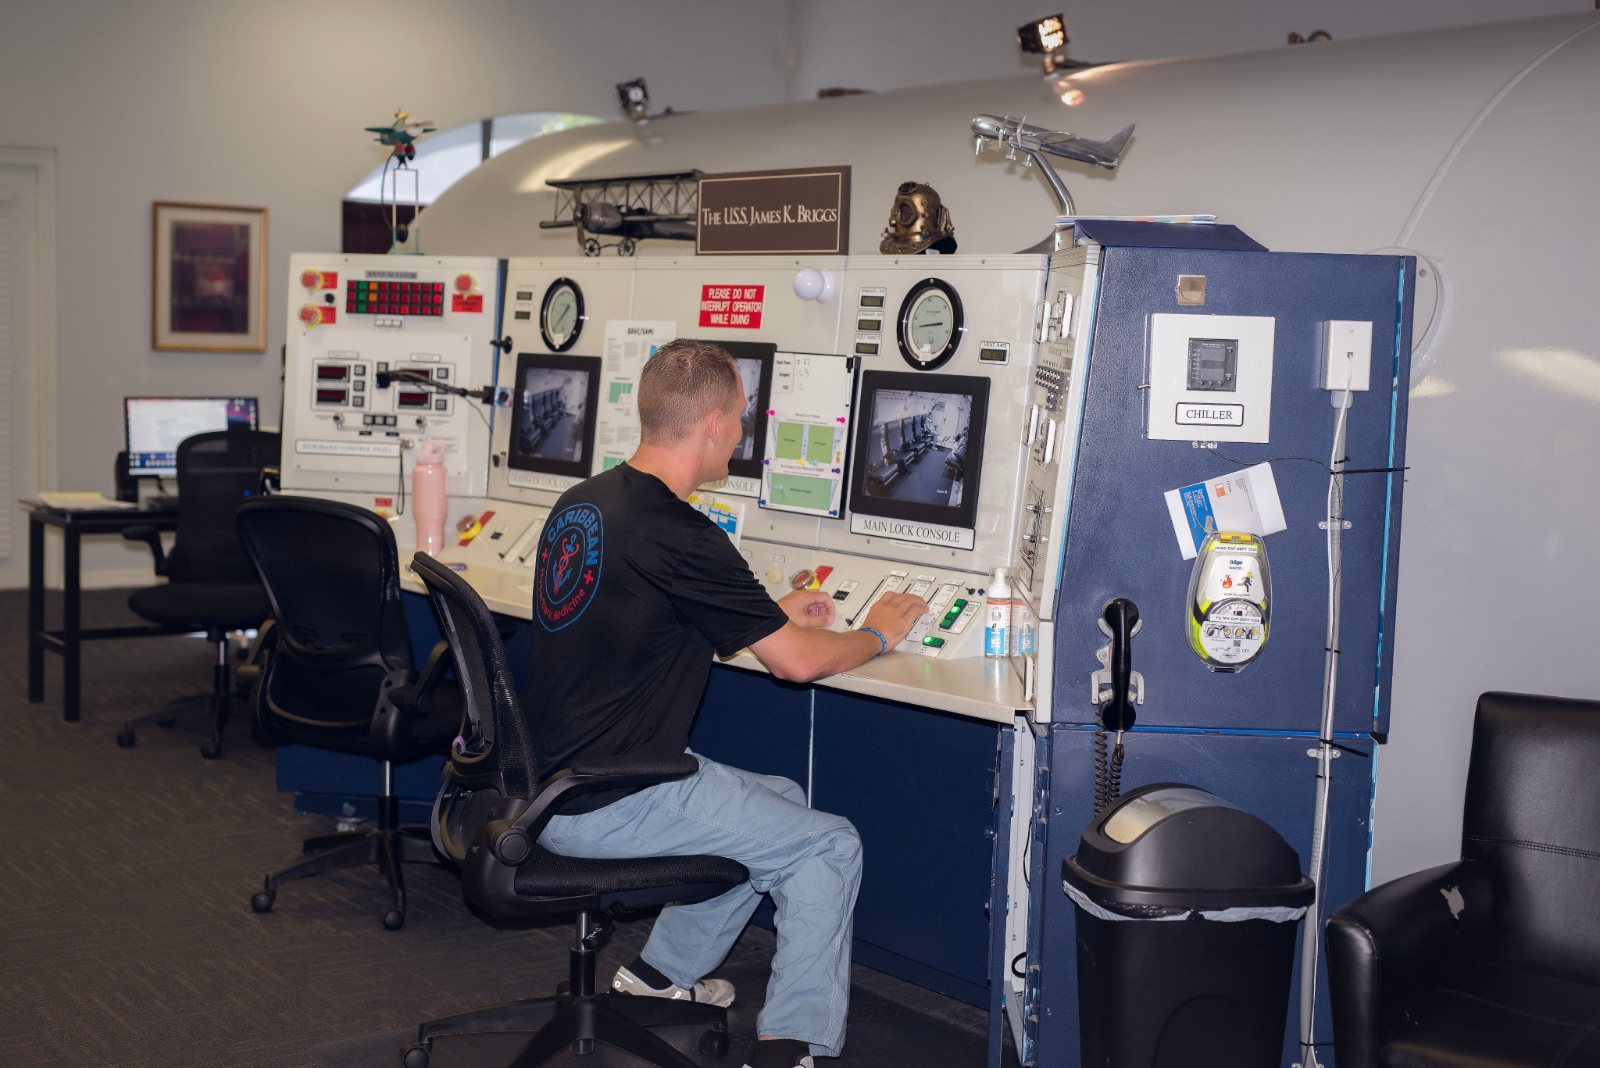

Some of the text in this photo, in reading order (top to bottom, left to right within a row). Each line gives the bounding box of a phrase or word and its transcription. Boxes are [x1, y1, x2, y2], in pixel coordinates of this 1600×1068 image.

[749, 205, 782, 227] JAMES
[783, 204, 796, 223] K.
[797, 204, 838, 223] BRIGGS
[708, 287, 758, 300] PLEASE DO NOT
[701, 300, 763, 313] INTERRUPT OPERATOR
[710, 313, 751, 325] WHILE DIVING
[1186, 409, 1233, 420] CHILLER
[547, 508, 599, 566] CARIBBEAN
[863, 519, 961, 543] MAIN LOCK CONSOLE
